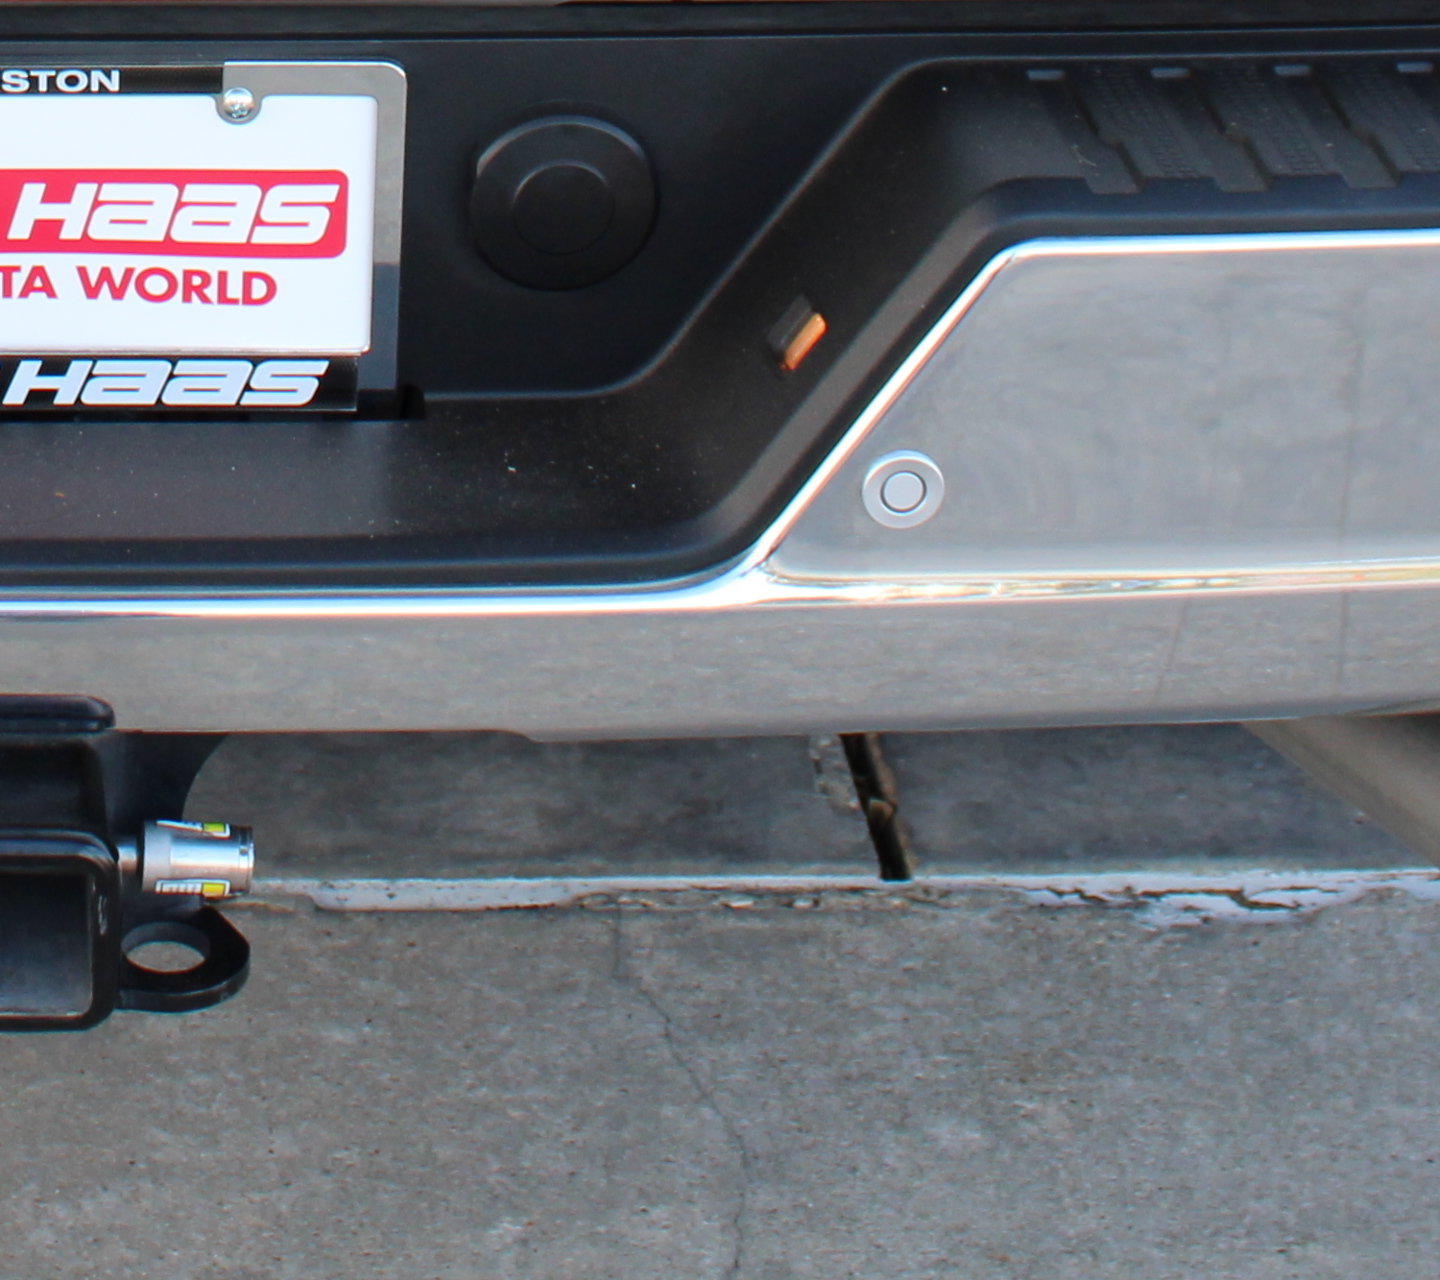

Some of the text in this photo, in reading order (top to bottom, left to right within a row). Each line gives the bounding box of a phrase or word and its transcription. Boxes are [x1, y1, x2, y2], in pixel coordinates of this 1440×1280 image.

[9, 183, 341, 244] Haas
[77, 266, 277, 307] WORLD
[3, 360, 329, 406] Haas
